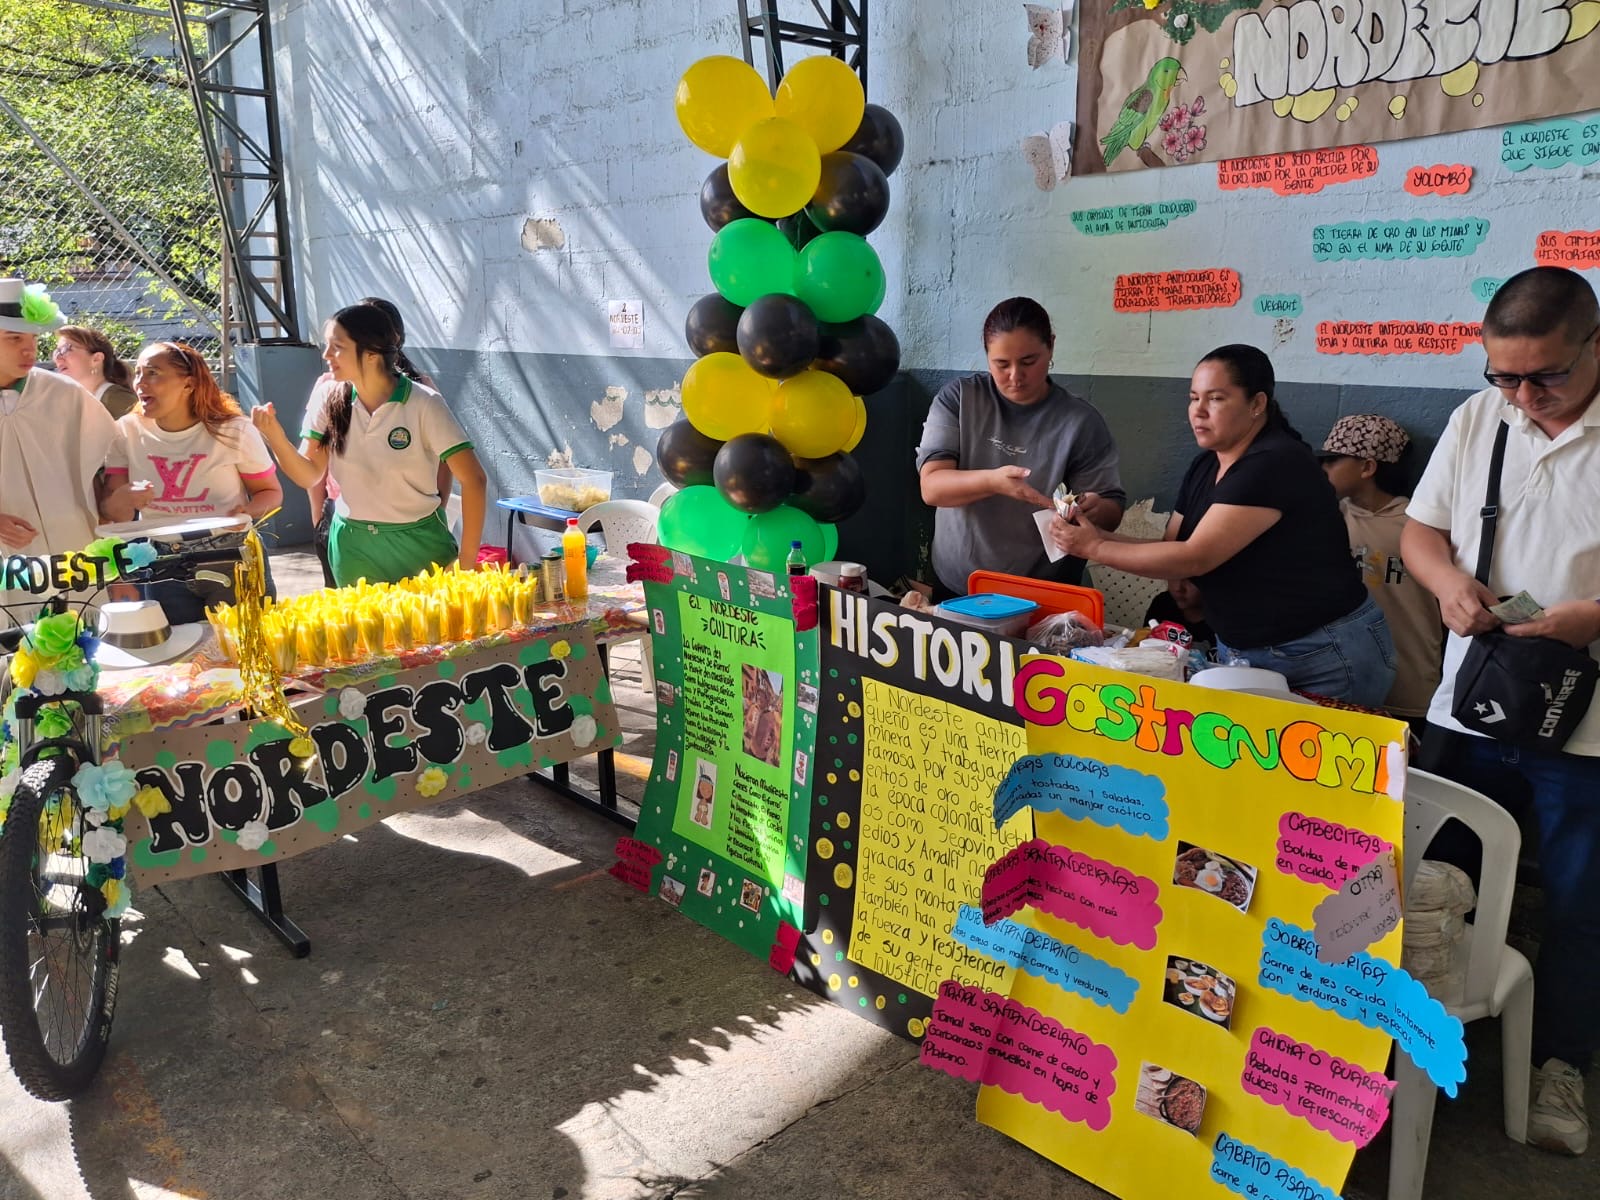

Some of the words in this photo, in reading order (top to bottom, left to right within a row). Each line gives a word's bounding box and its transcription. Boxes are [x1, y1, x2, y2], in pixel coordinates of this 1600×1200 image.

[1502, 148, 1526, 162] QUE
[1535, 144, 1574, 160] SIGUE
[1521, 128, 1570, 144] NORDESTE
[1583, 125, 1599, 138] ES
[1350, 147, 1370, 160] POR
[1413, 167, 1467, 187] YOLOMBÓ
[1313, 227, 1325, 240] ES
[1330, 227, 1362, 241] TIERRA
[1368, 226, 1378, 239] DE
[1384, 227, 1401, 239] ORO
[1405, 226, 1417, 239] EN
[1422, 225, 1437, 238] LAS
[1441, 222, 1470, 238] MINAS
[1476, 223, 1483, 236] Y
[1313, 241, 1333, 254] ORO
[1339, 242, 1351, 254] EN
[1400, 240, 1413, 252] DE
[1432, 238, 1465, 253] GENTE
[1540, 235, 1557, 247] SUS
[1220, 269, 1230, 281] ES
[1231, 281, 1238, 293] Y
[1332, 322, 1374, 336] NORDESTE
[1438, 323, 1449, 336] ES
[1342, 337, 1348, 351] Y
[1394, 336, 1413, 350] QUE
[1418, 337, 1459, 351] RESISTE
[0, 536, 151, 595] RDESTE
[709, 600, 759, 628] NORDESTE
[709, 617, 759, 649] CULTURA
[830, 588, 1042, 708] HISTORI
[865, 682, 879, 703] El
[888, 689, 964, 731] Nordeste
[1537, 668, 1583, 738] CONVERSE
[866, 704, 910, 734] queño
[919, 722, 937, 743] es
[945, 728, 969, 753] una
[976, 736, 1017, 765] tierra
[869, 723, 913, 752] minera
[921, 739, 930, 757] y
[134, 659, 574, 854] NORDESTE
[868, 739, 916, 773] famosa
[954, 770, 980, 794] sus
[866, 763, 908, 790] entos
[914, 773, 929, 797] de
[937, 787, 961, 806] oro
[866, 779, 879, 800] la
[888, 786, 926, 815] época
[1048, 791, 1063, 802] un
[1069, 795, 1105, 814] manjar
[862, 824, 901, 850] edios
[904, 835, 916, 854] y
[919, 839, 960, 871] Amalfi
[863, 803, 883, 821] os
[887, 809, 925, 836] como
[938, 825, 996, 863] Segovia
[1287, 811, 1382, 856] CABECITAS
[863, 846, 916, 880] gracias
[923, 868, 934, 884] a
[944, 868, 957, 894] la
[1277, 857, 1294, 874] en
[1282, 839, 1325, 866] Bolitas
[1334, 854, 1349, 873] de
[862, 870, 877, 888] de
[884, 876, 908, 897] sus
[862, 883, 910, 919] también
[915, 902, 936, 929] han
[857, 902, 868, 922] la
[872, 907, 911, 941] fuerza
[919, 930, 929, 947] y
[932, 934, 1006, 981] resistencia
[857, 924, 871, 946] de
[882, 940, 901, 957] su
[905, 951, 943, 978] gente
[851, 942, 864, 963] la
[873, 954, 940, 995] injusticia
[1296, 981, 1349, 1010] verduras
[1299, 965, 1314, 984] de
[1319, 975, 1338, 992] res
[1344, 984, 1388, 1009] cocida
[1393, 1001, 1438, 1051] lentamente
[980, 997, 1089, 1058] SANTANDERIANO
[927, 1023, 985, 1054] Garbanzos
[986, 1044, 1032, 1073] envueltos
[1033, 1064, 1048, 1082] en
[1051, 1072, 1081, 1099] hojas
[1084, 1088, 1100, 1107] de
[935, 1009, 966, 1029] Tamal
[968, 1021, 992, 1040] seco
[1045, 1051, 1060, 1068] de
[1060, 1061, 1090, 1084] cerdo
[1259, 1030, 1307, 1062] CHICHA
[1308, 1052, 1323, 1067] O
[1243, 1070, 1280, 1097] dulces
[1248, 1050, 1299, 1087] Bebidas
[1214, 1131, 1272, 1178] CABRITO
[1246, 1181, 1260, 1198] de
